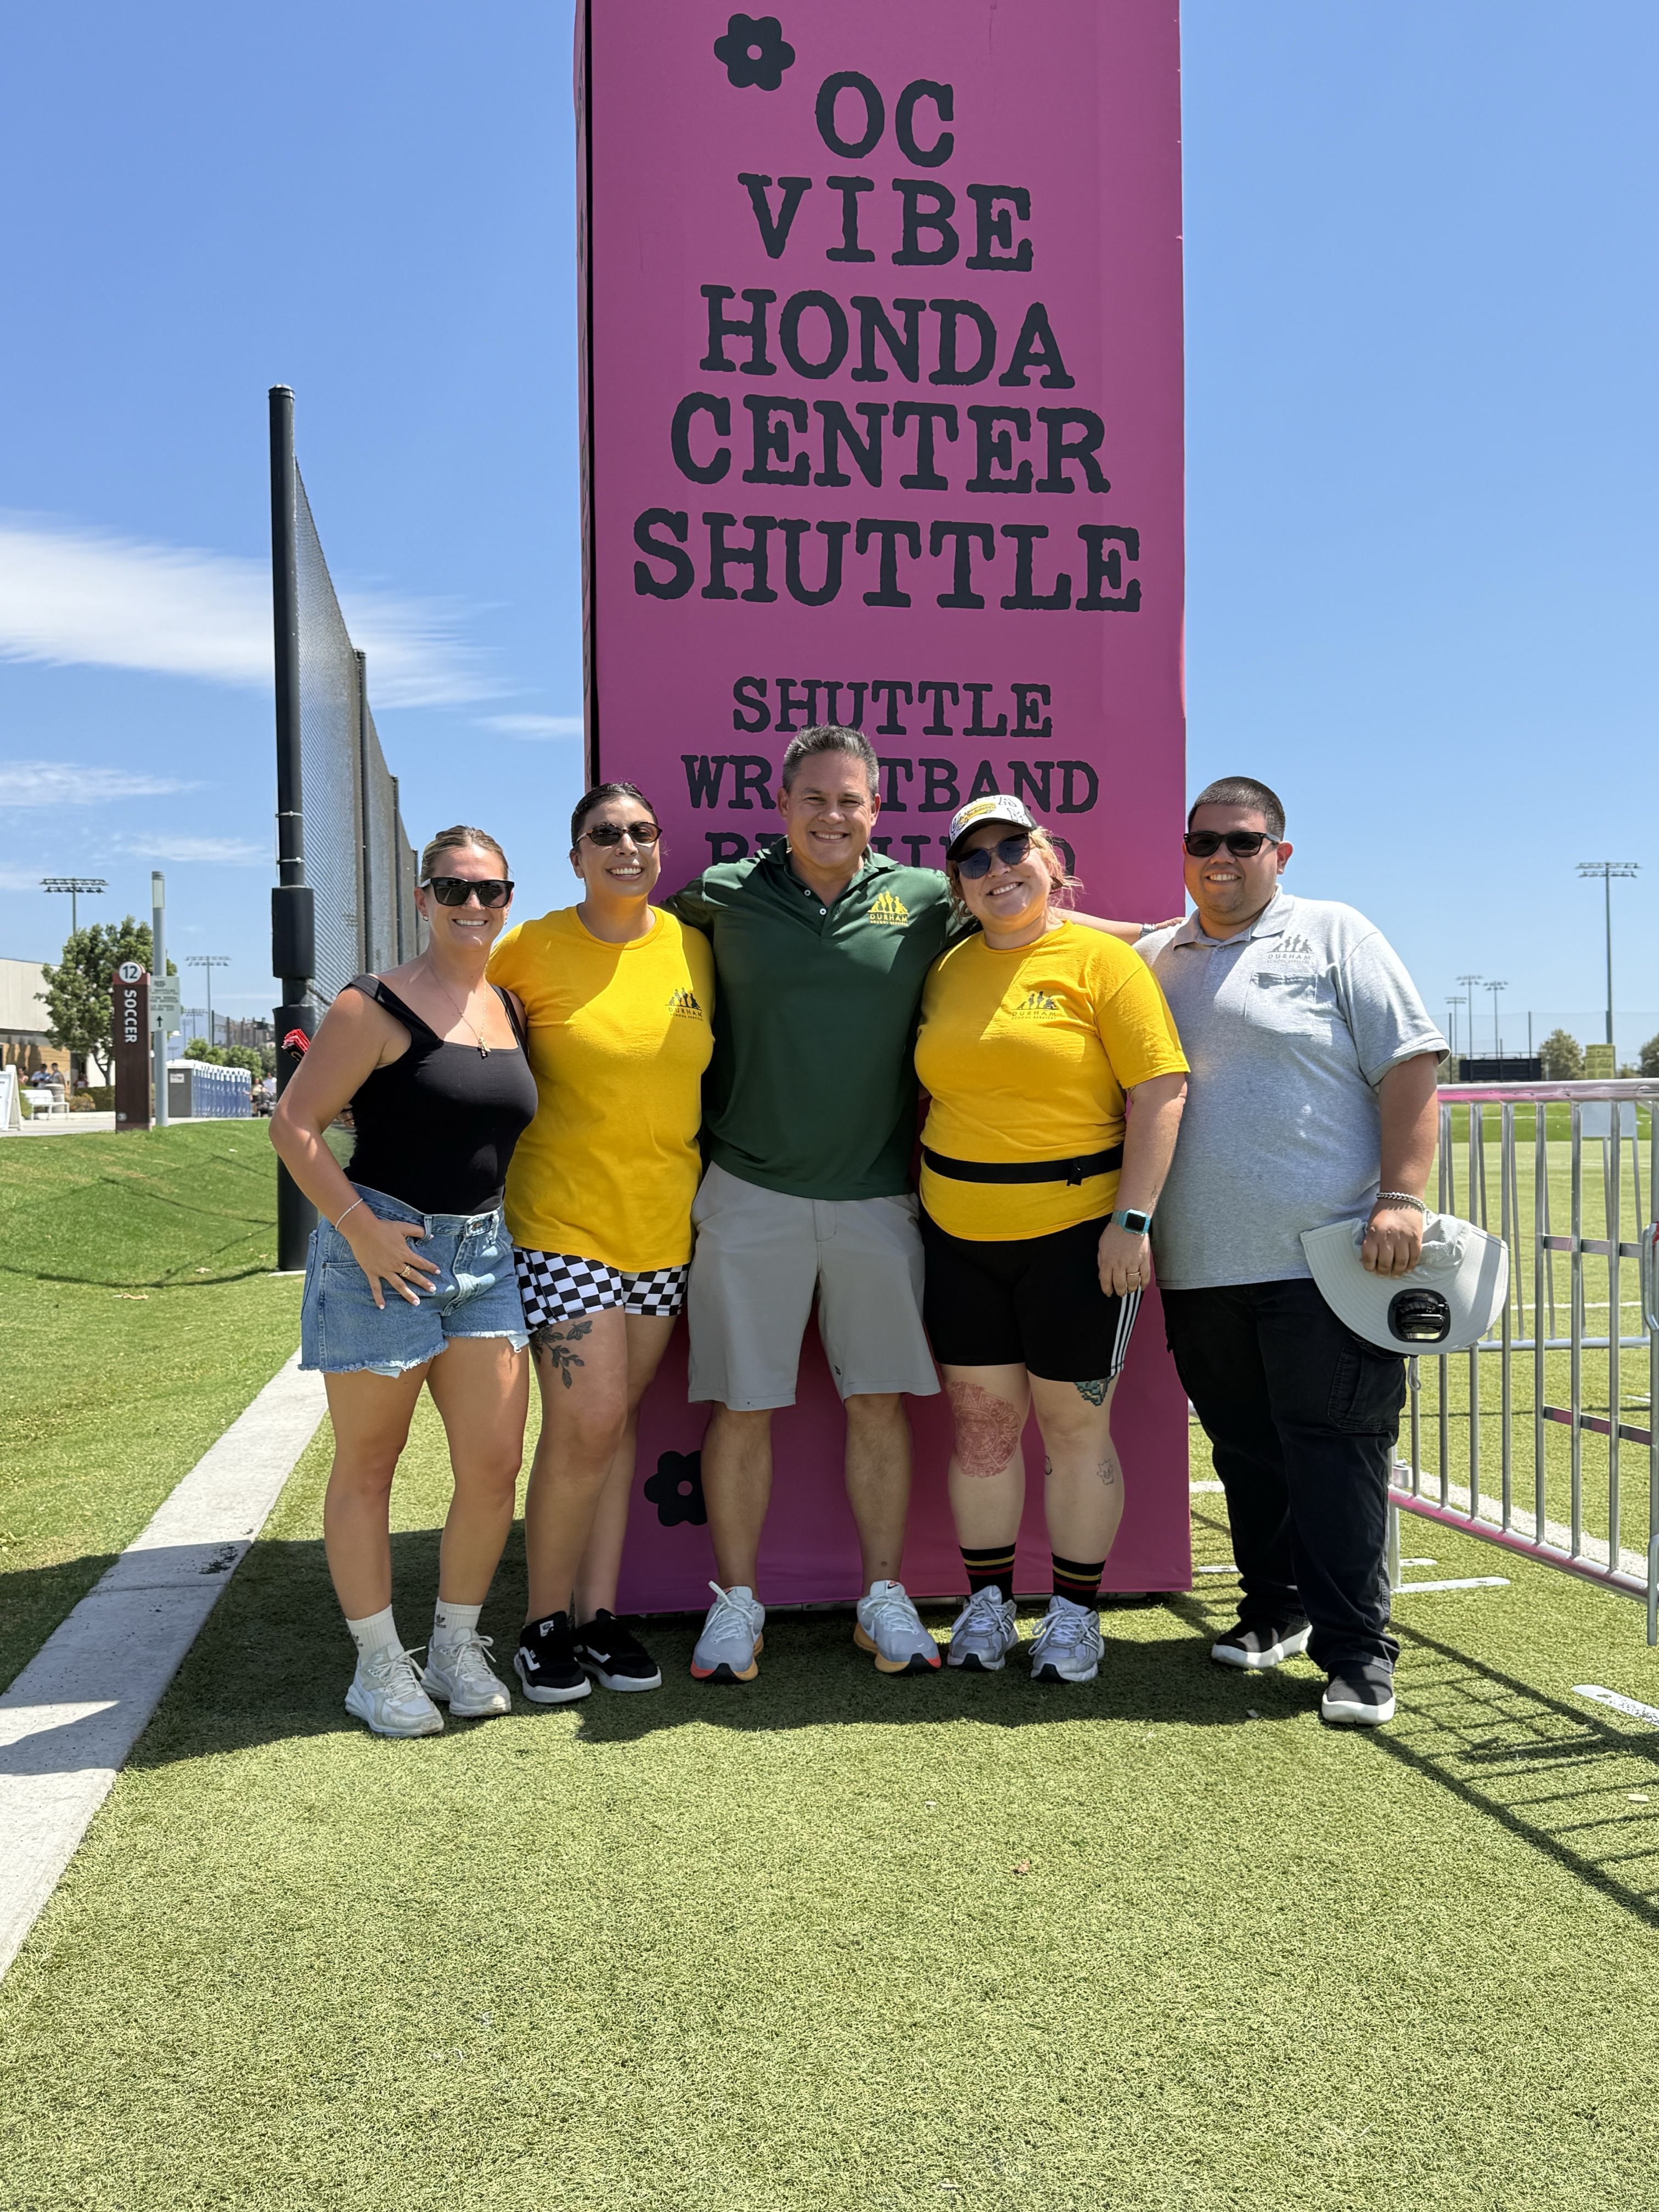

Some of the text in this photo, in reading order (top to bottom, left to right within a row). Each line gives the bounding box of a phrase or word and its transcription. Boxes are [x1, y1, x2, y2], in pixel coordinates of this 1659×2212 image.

[815, 71, 954, 167] OC
[738, 173, 1034, 272] VIBE
[700, 285, 1076, 389] HONDA
[671, 392, 1111, 494] CENTER
[634, 508, 1142, 612] SHUTTLE
[733, 676, 1053, 738] SHUTTLE
[681, 755, 1099, 814] WRTBAND
[870, 913, 908, 922] DURHAM
[122, 965, 138, 979] 12
[124, 989, 137, 1043] SOCCER
[668, 1007, 702, 1017] DURHAM
